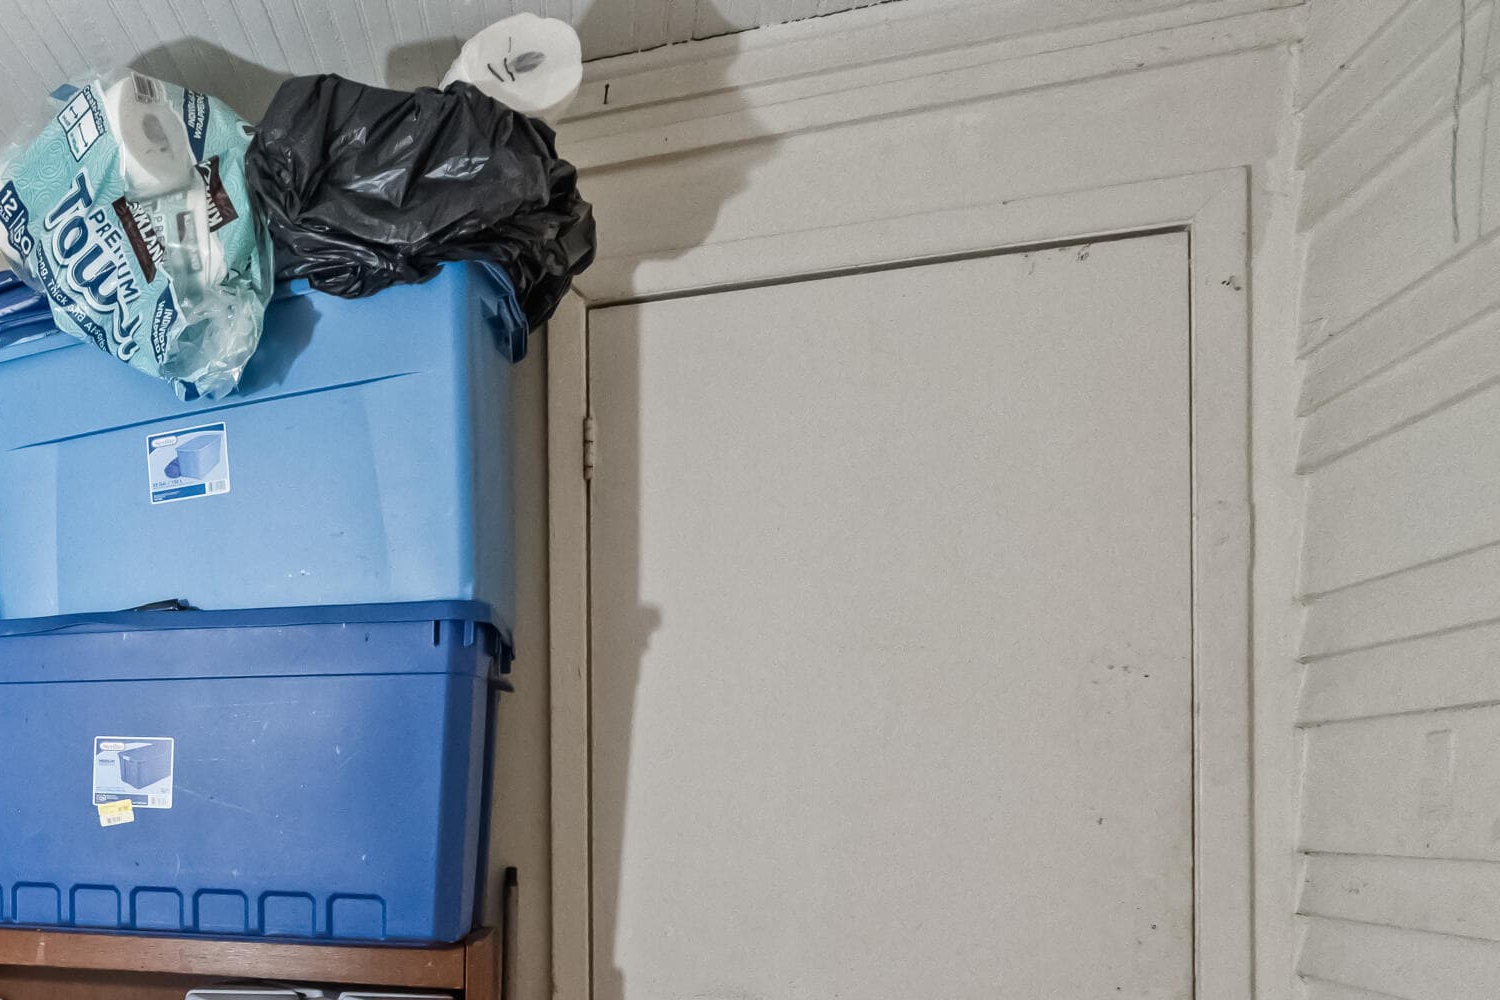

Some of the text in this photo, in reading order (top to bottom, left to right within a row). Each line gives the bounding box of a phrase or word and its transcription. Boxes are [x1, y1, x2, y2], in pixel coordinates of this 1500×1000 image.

[2, 190, 32, 256] 12 160
[47, 277, 68, 307] Thick
